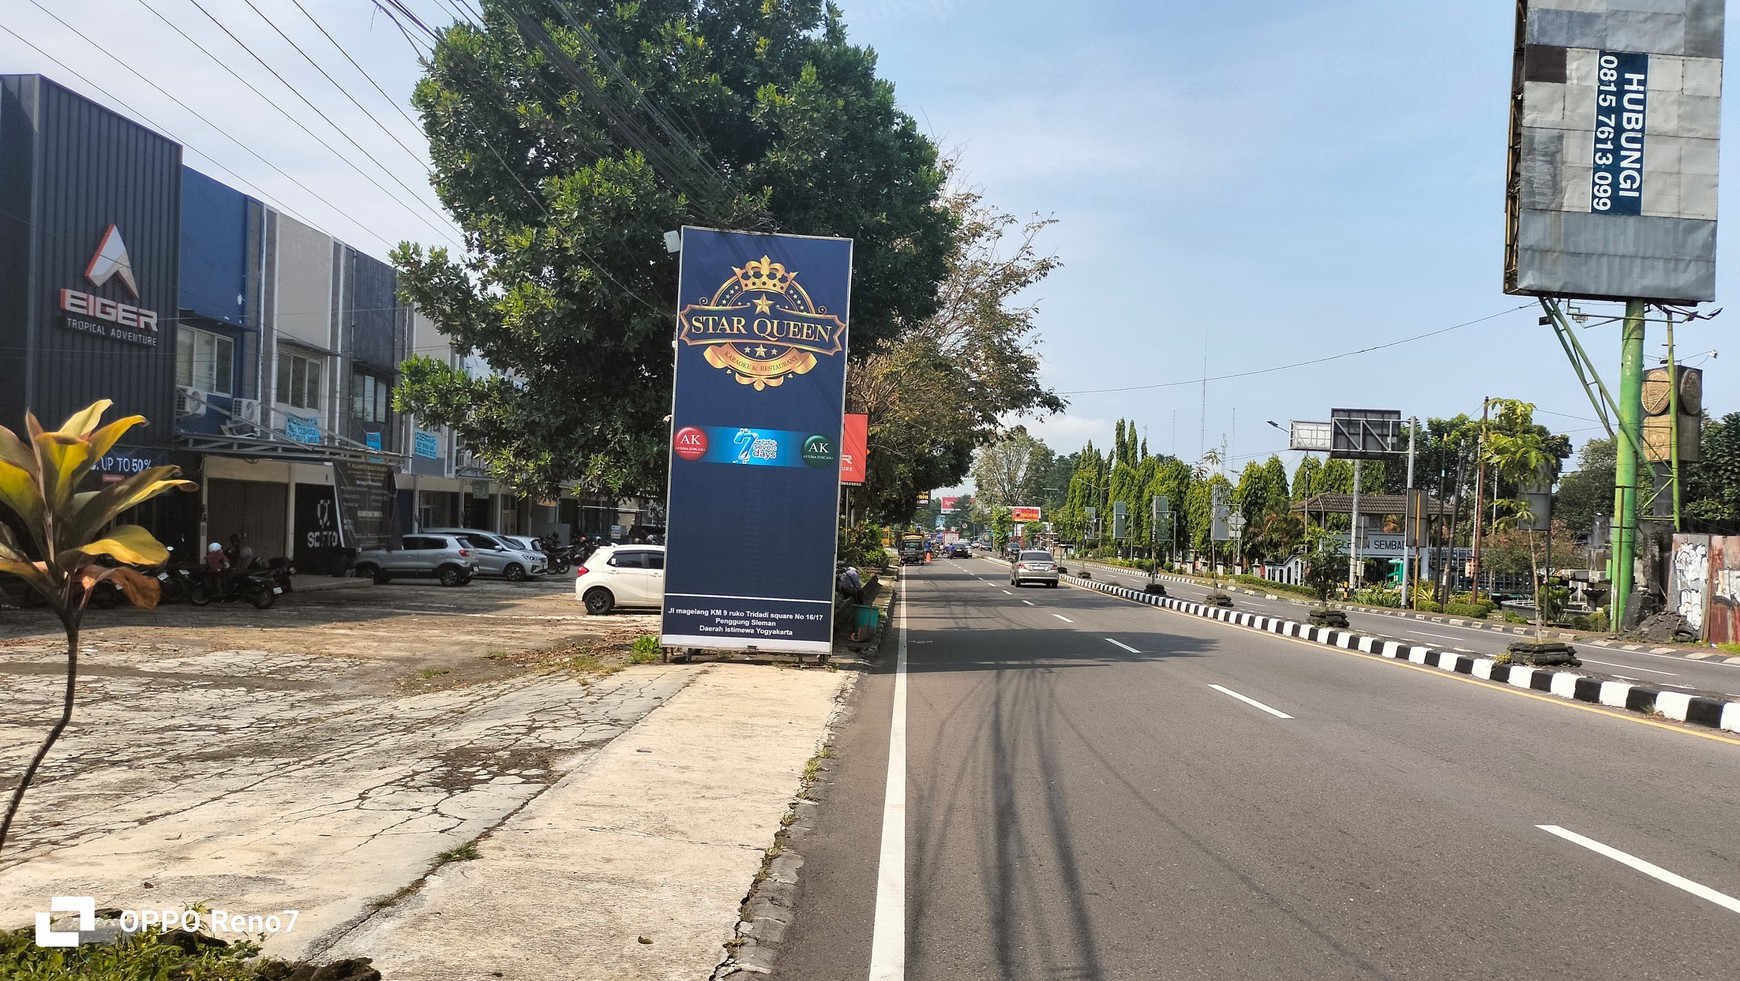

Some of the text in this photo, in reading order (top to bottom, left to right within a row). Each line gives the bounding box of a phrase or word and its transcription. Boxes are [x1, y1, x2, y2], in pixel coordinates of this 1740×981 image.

[1592, 55, 1618, 211] 0815 7613 099
[1619, 72, 1645, 197] HUBUNGI
[60, 288, 158, 331] EIGER
[66, 317, 157, 346] TROPICAL ADVENTURE
[691, 315, 832, 343] STAR QUEEN
[723, 351, 751, 369] KARAOKE
[760, 355, 798, 372] RESTAURANT
[680, 434, 701, 445] AK
[808, 442, 829, 453] AK
[100, 456, 114, 471] UP
[116, 457, 130, 472] TO
[132, 458, 152, 472] 50%
[676, 608, 709, 617] magelang
[770, 613, 793, 621] square
[715, 618, 750, 627] Penggung
[725, 626, 755, 634] Istimewa
[756, 627, 793, 636] Yogyakarta
